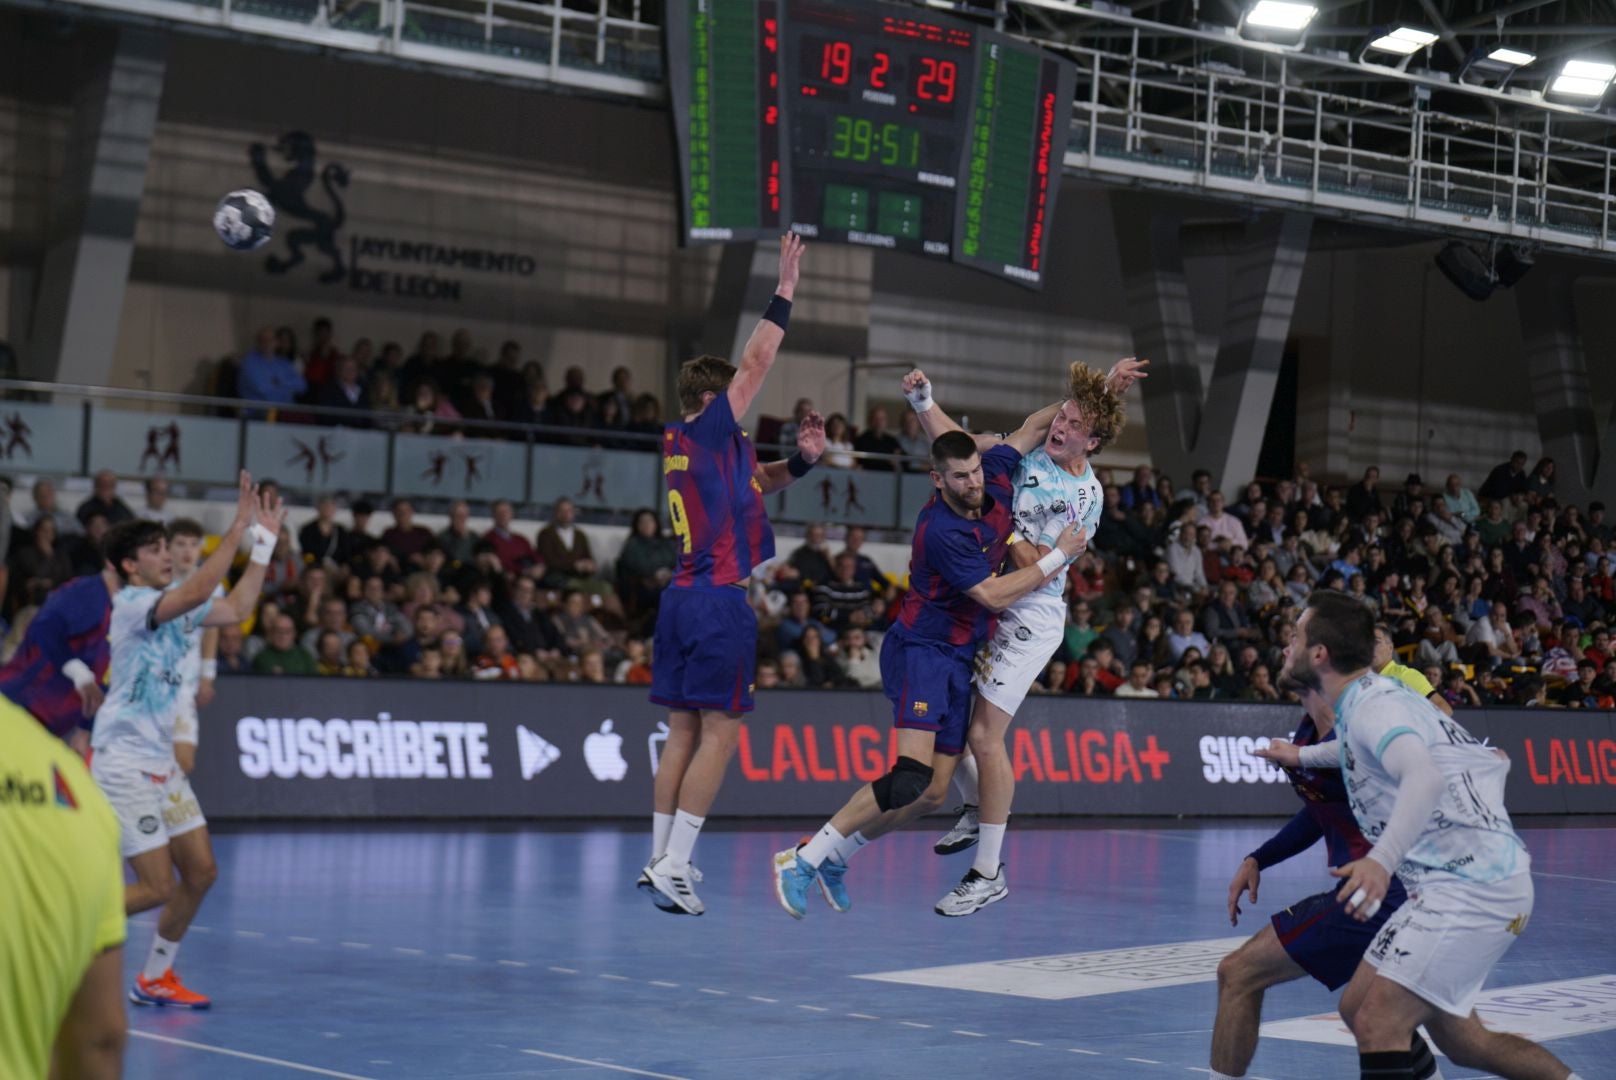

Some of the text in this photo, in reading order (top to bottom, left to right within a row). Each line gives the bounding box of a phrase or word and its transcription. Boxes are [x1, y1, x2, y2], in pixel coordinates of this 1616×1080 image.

[822, 42, 957, 104] 19 2 29
[832, 116, 921, 167] 39:51
[361, 236, 537, 278] AYUNTAMIENTO
[352, 269, 461, 300] DE LEÓN
[739, 723, 1170, 783] LALIG ALIGA+
[1199, 731, 1296, 784] SUSC
